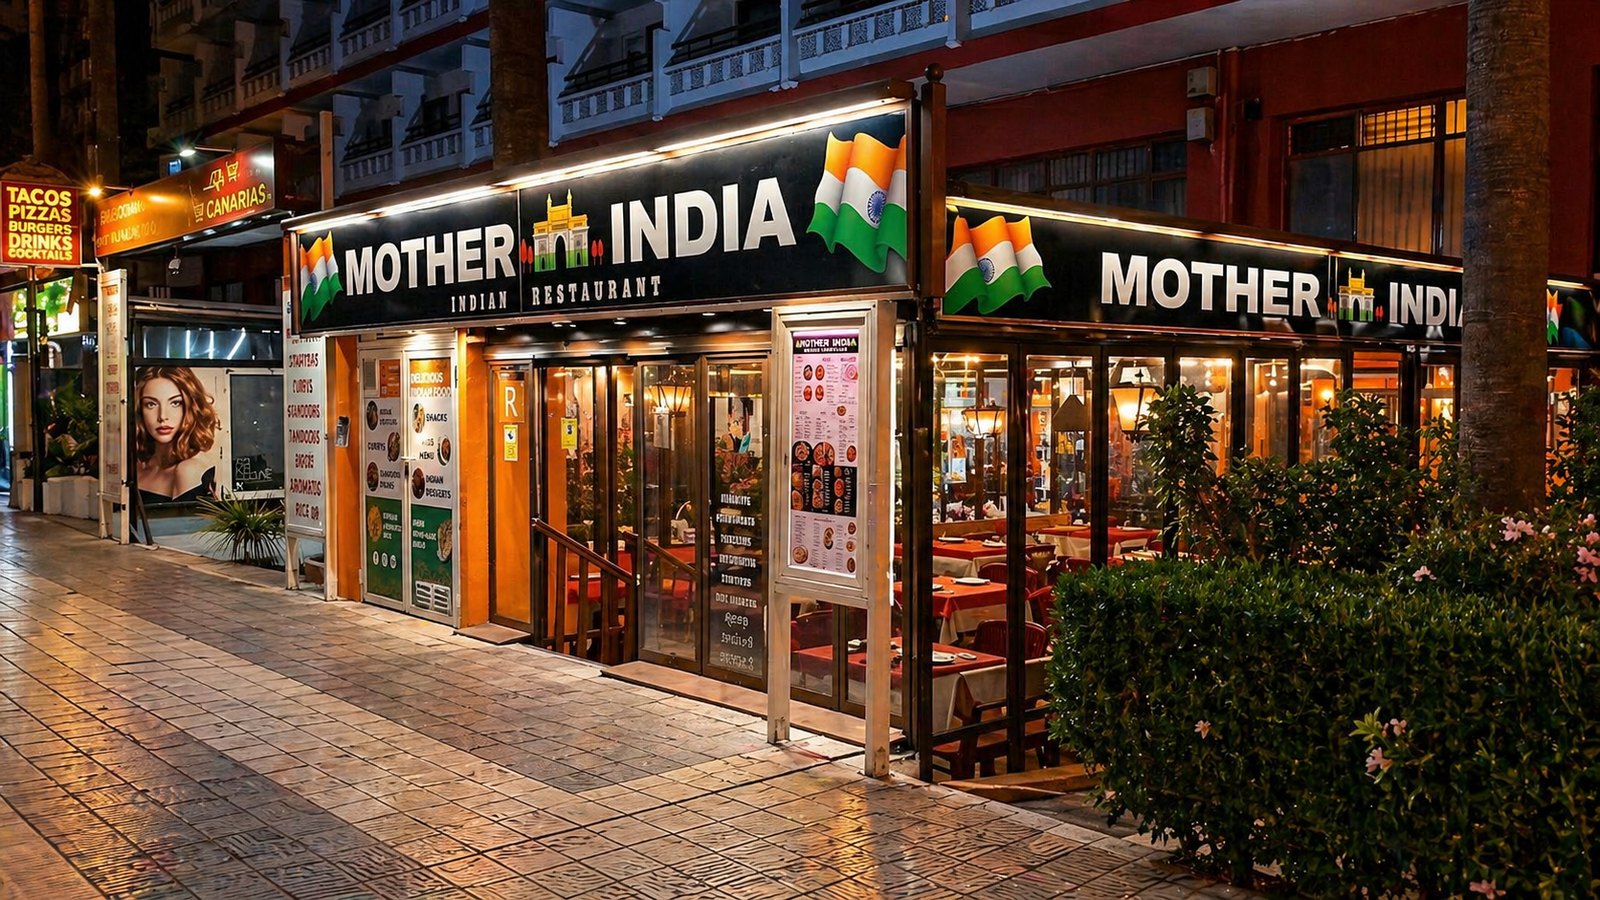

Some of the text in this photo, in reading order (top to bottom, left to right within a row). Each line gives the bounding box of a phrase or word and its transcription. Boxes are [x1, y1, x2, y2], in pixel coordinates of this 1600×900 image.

[6, 186, 72, 207] TACOS
[206, 183, 266, 219] CANARIAS
[8, 204, 72, 223] PIZZAS
[8, 220, 73, 235] BURGERS
[345, 176, 797, 296] MOTHER INDIA
[8, 232, 73, 251] DRINKS
[8, 248, 73, 261] COCKTAILS
[451, 275, 661, 313] INDIAN RESTAURANT
[1101, 251, 1463, 327] MOTHER INDI
[505, 386, 518, 417] R
